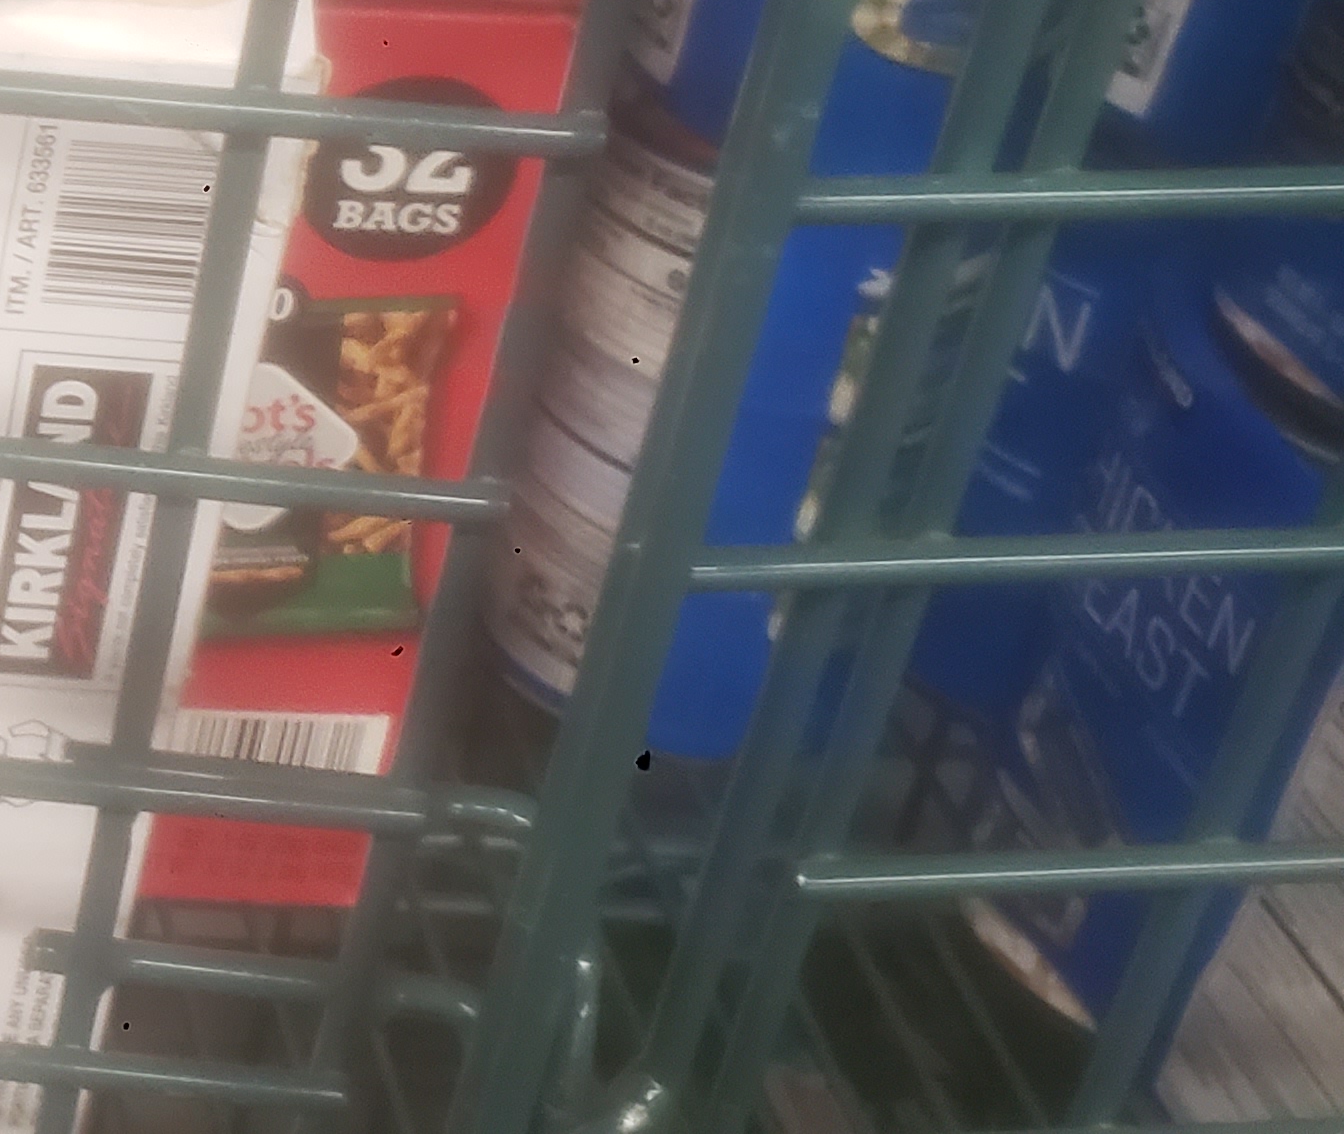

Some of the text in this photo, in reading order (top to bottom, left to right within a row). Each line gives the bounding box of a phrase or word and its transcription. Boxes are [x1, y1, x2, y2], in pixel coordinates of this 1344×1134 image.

[341, 144, 475, 194] 32
[17, 199, 42, 250] ART.
[333, 199, 462, 235] BAGS
[6, 268, 32, 316] ITM.
[242, 393, 316, 435] ot's
